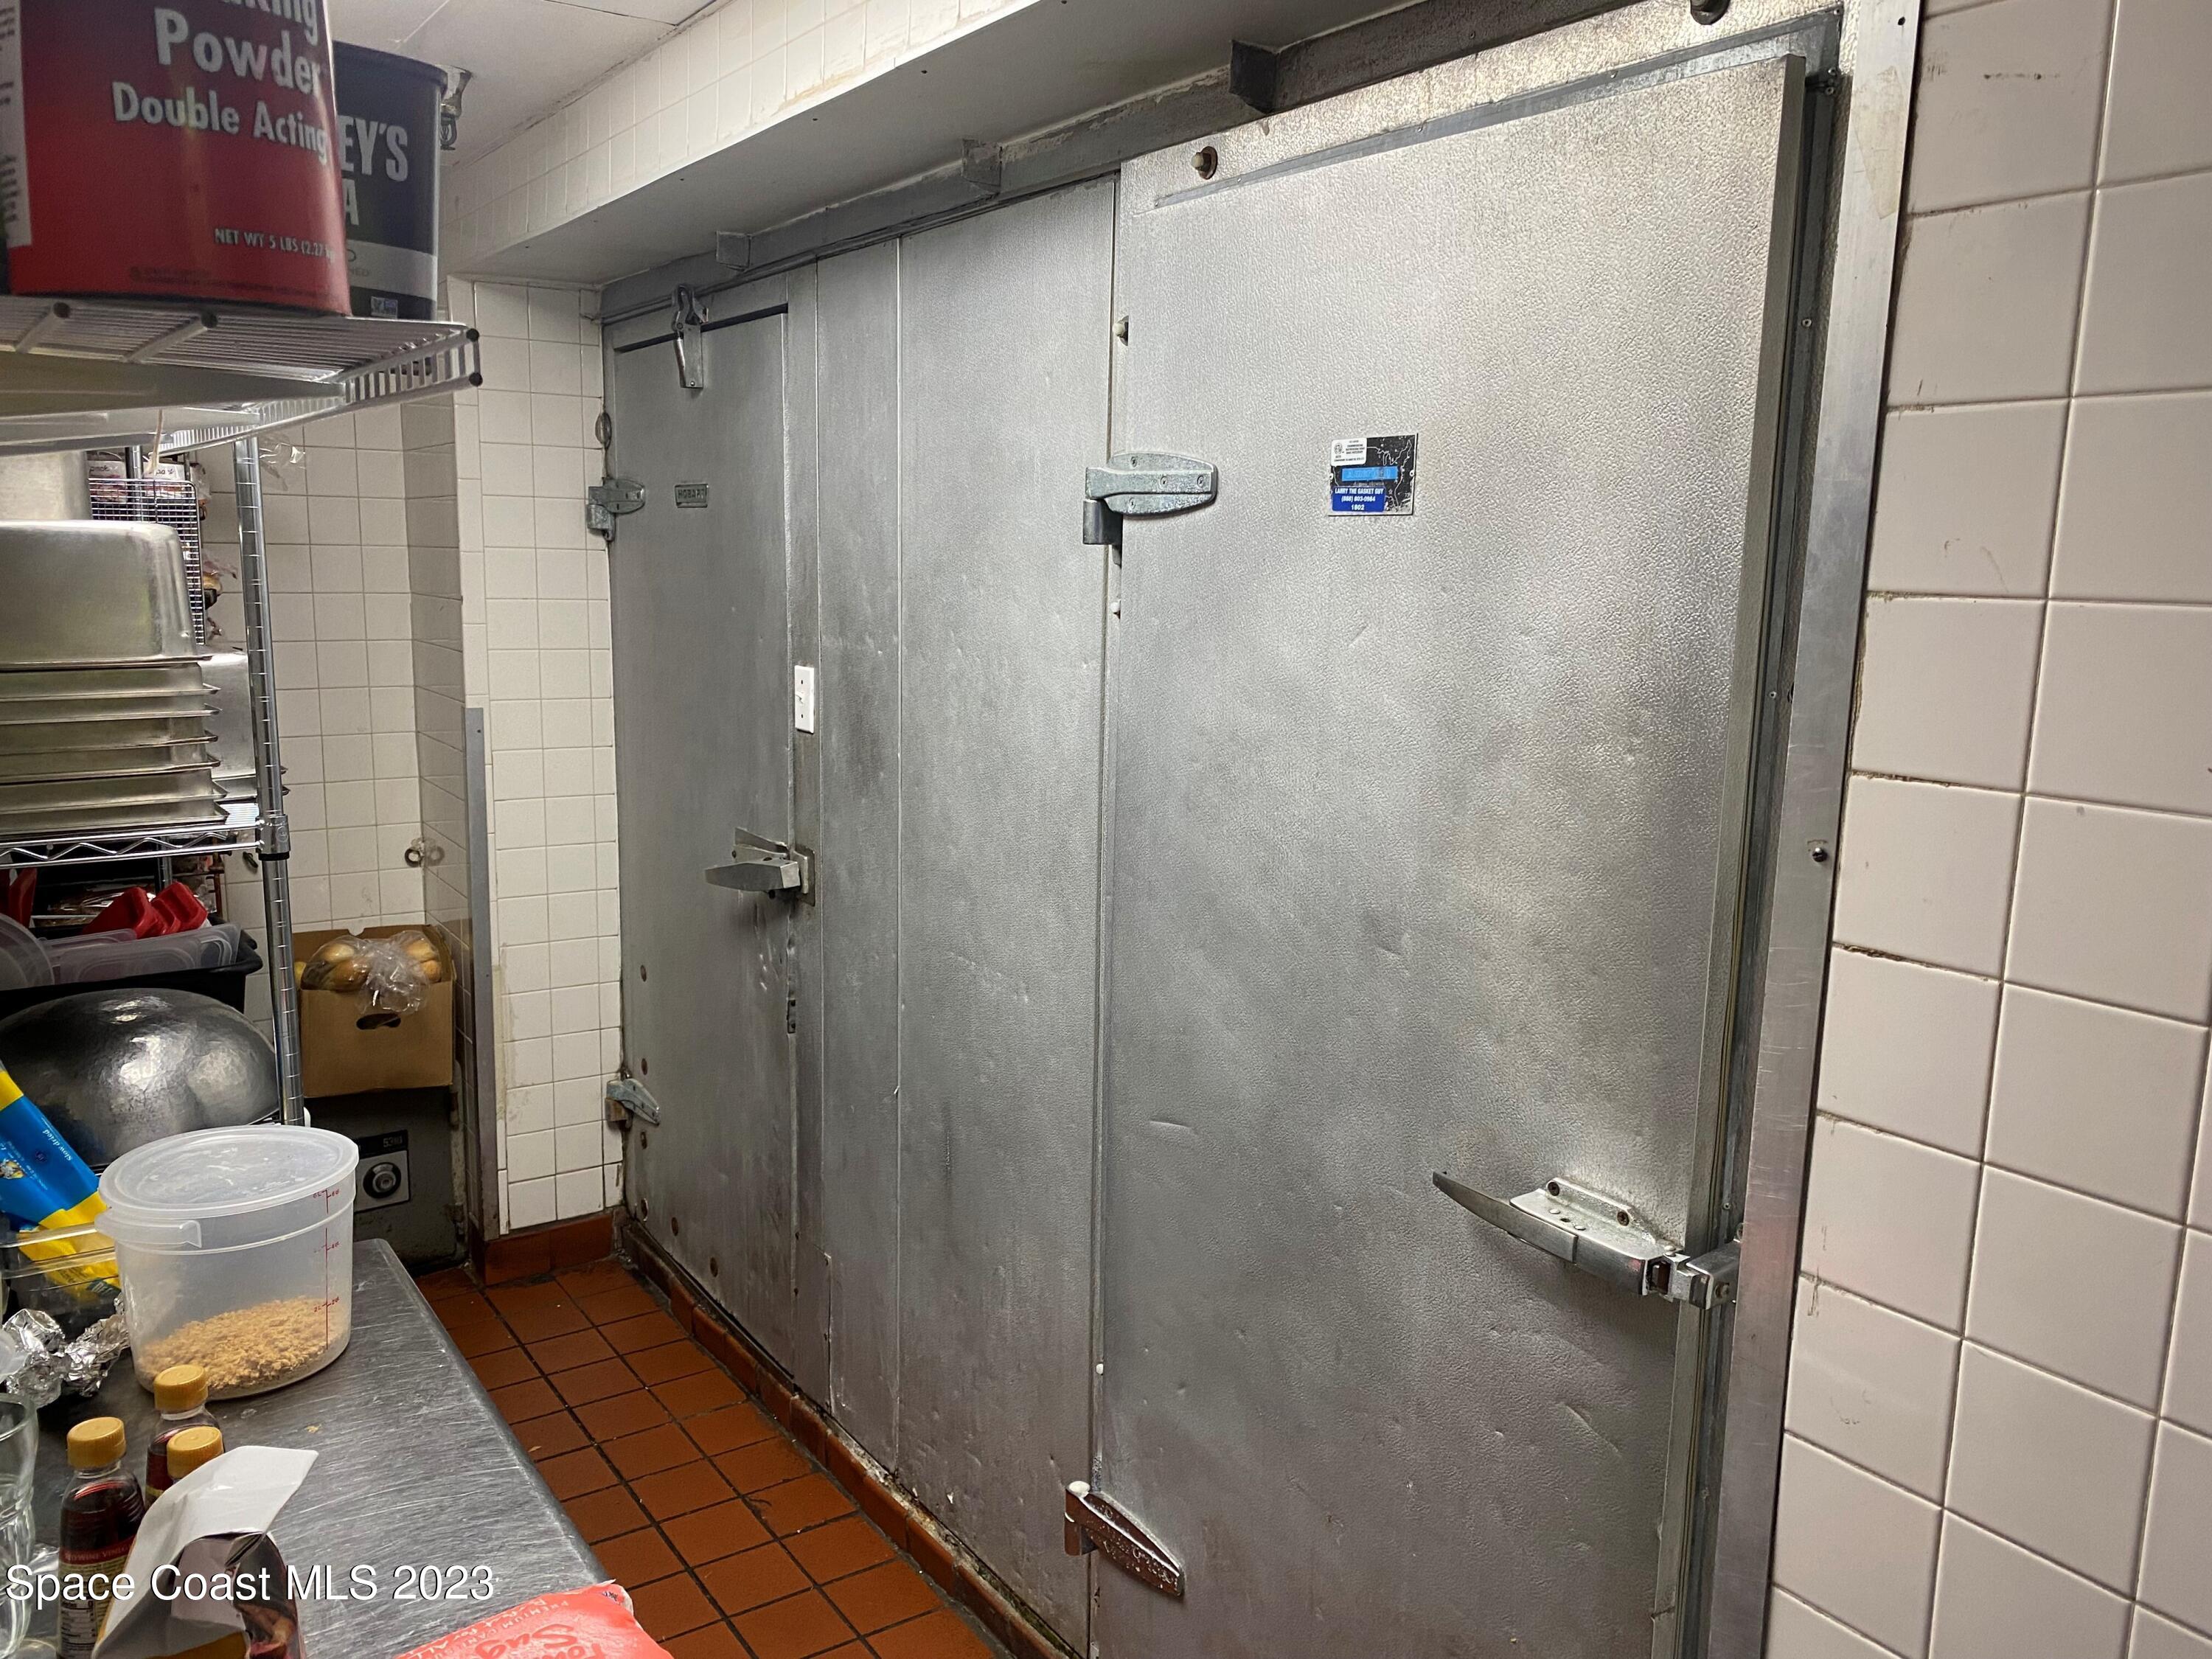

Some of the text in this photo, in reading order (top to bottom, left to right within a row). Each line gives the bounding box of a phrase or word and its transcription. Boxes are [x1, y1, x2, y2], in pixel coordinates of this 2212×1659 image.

[154, 7, 321, 97] Powder
[112, 81, 327, 165] Double Acting
[215, 228, 239, 245] NET
[244, 232, 264, 248] WT
[269, 235, 276, 249] 5
[280, 237, 298, 251] LBS
[42, 1130, 59, 1146] dried
[484, 1598, 547, 1628] Prfect
